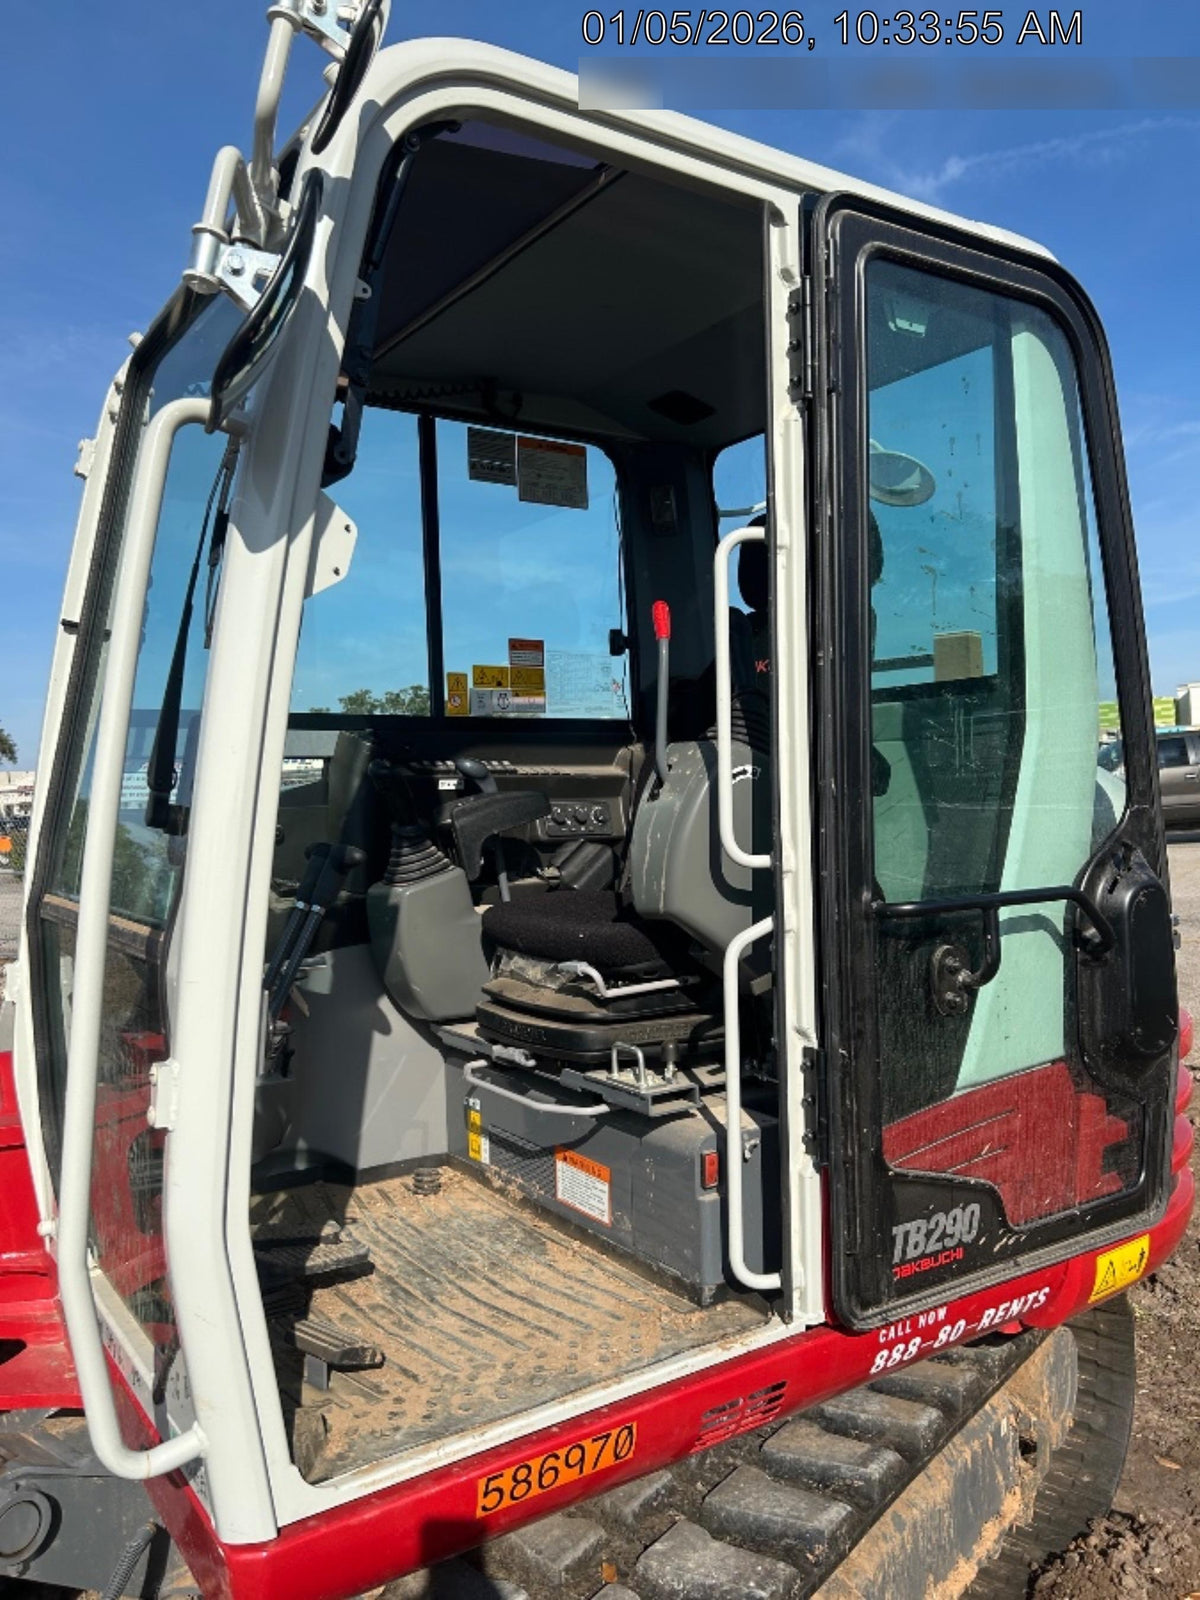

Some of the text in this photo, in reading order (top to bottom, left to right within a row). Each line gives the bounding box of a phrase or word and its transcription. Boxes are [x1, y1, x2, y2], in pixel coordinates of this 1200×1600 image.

[892, 1203, 981, 1264] TB290
[869, 1286, 1050, 1374] 888-80-RENTS
[879, 1306, 947, 1343] CALL NOW
[481, 1423, 634, 1512] 586970
